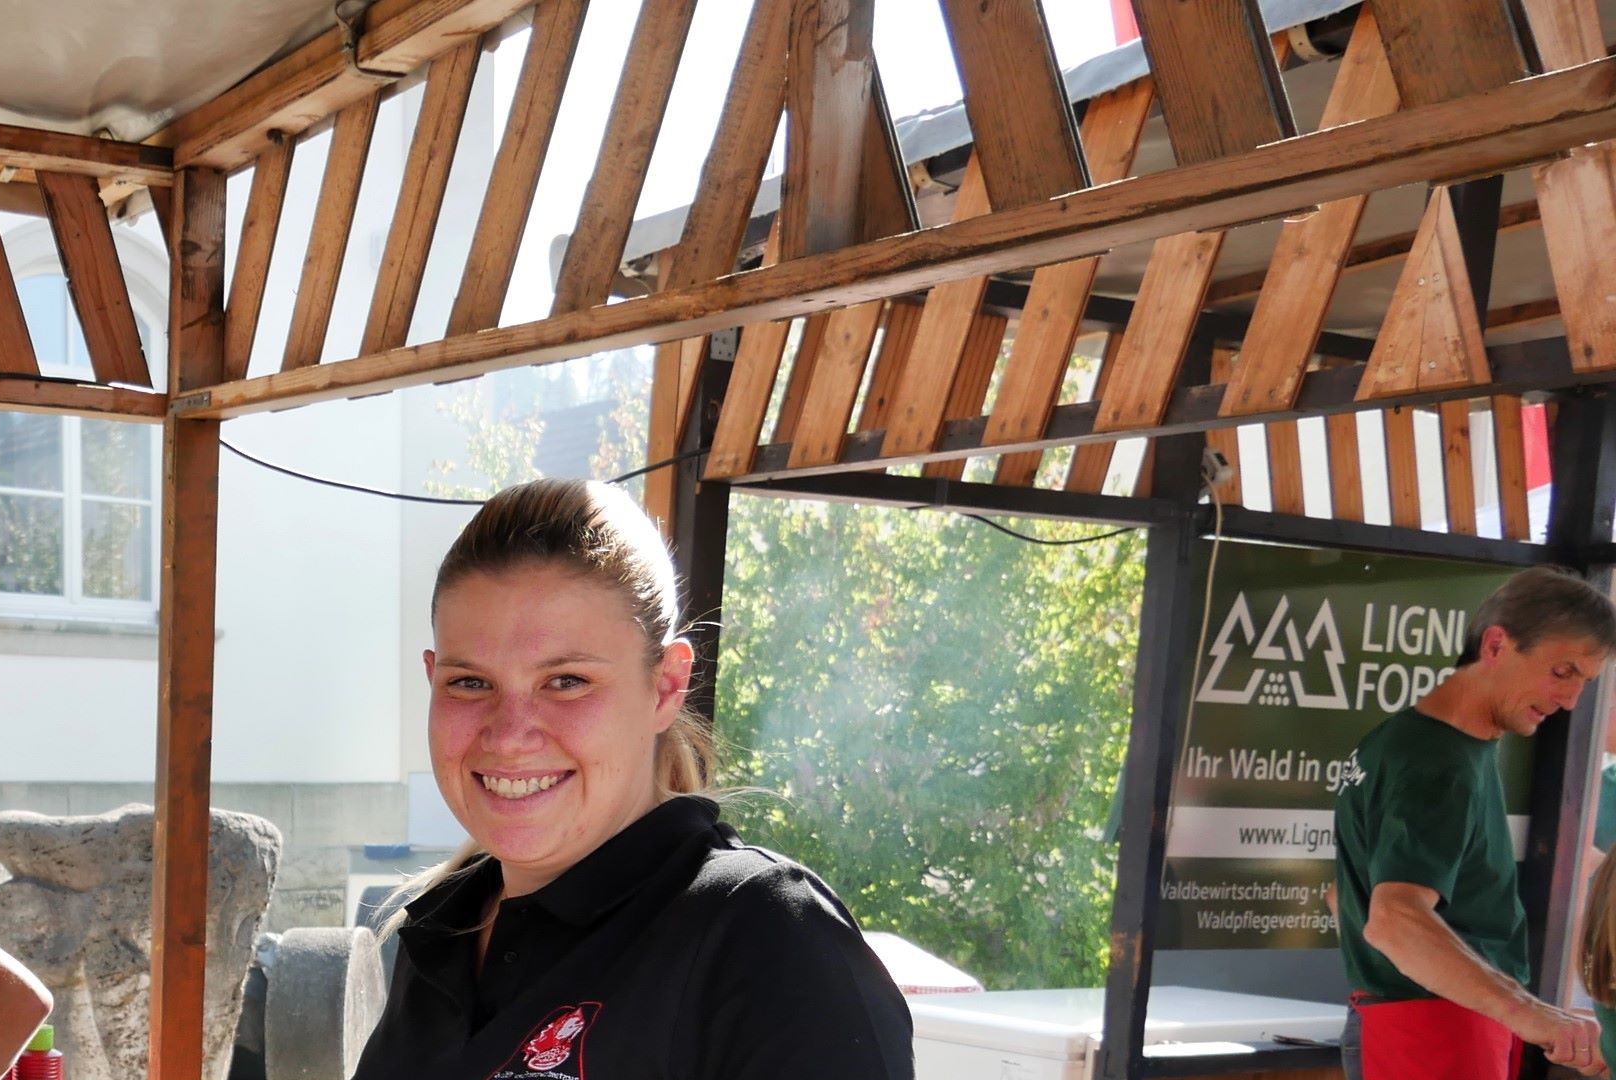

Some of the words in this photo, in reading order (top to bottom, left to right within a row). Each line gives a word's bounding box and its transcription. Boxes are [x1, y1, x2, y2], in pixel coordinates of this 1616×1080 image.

[1186, 745, 1223, 778] Ihr
[1229, 747, 1293, 781] Wald
[1297, 750, 1321, 781] in
[1197, 909, 1337, 934] Waldpflegeverträge
